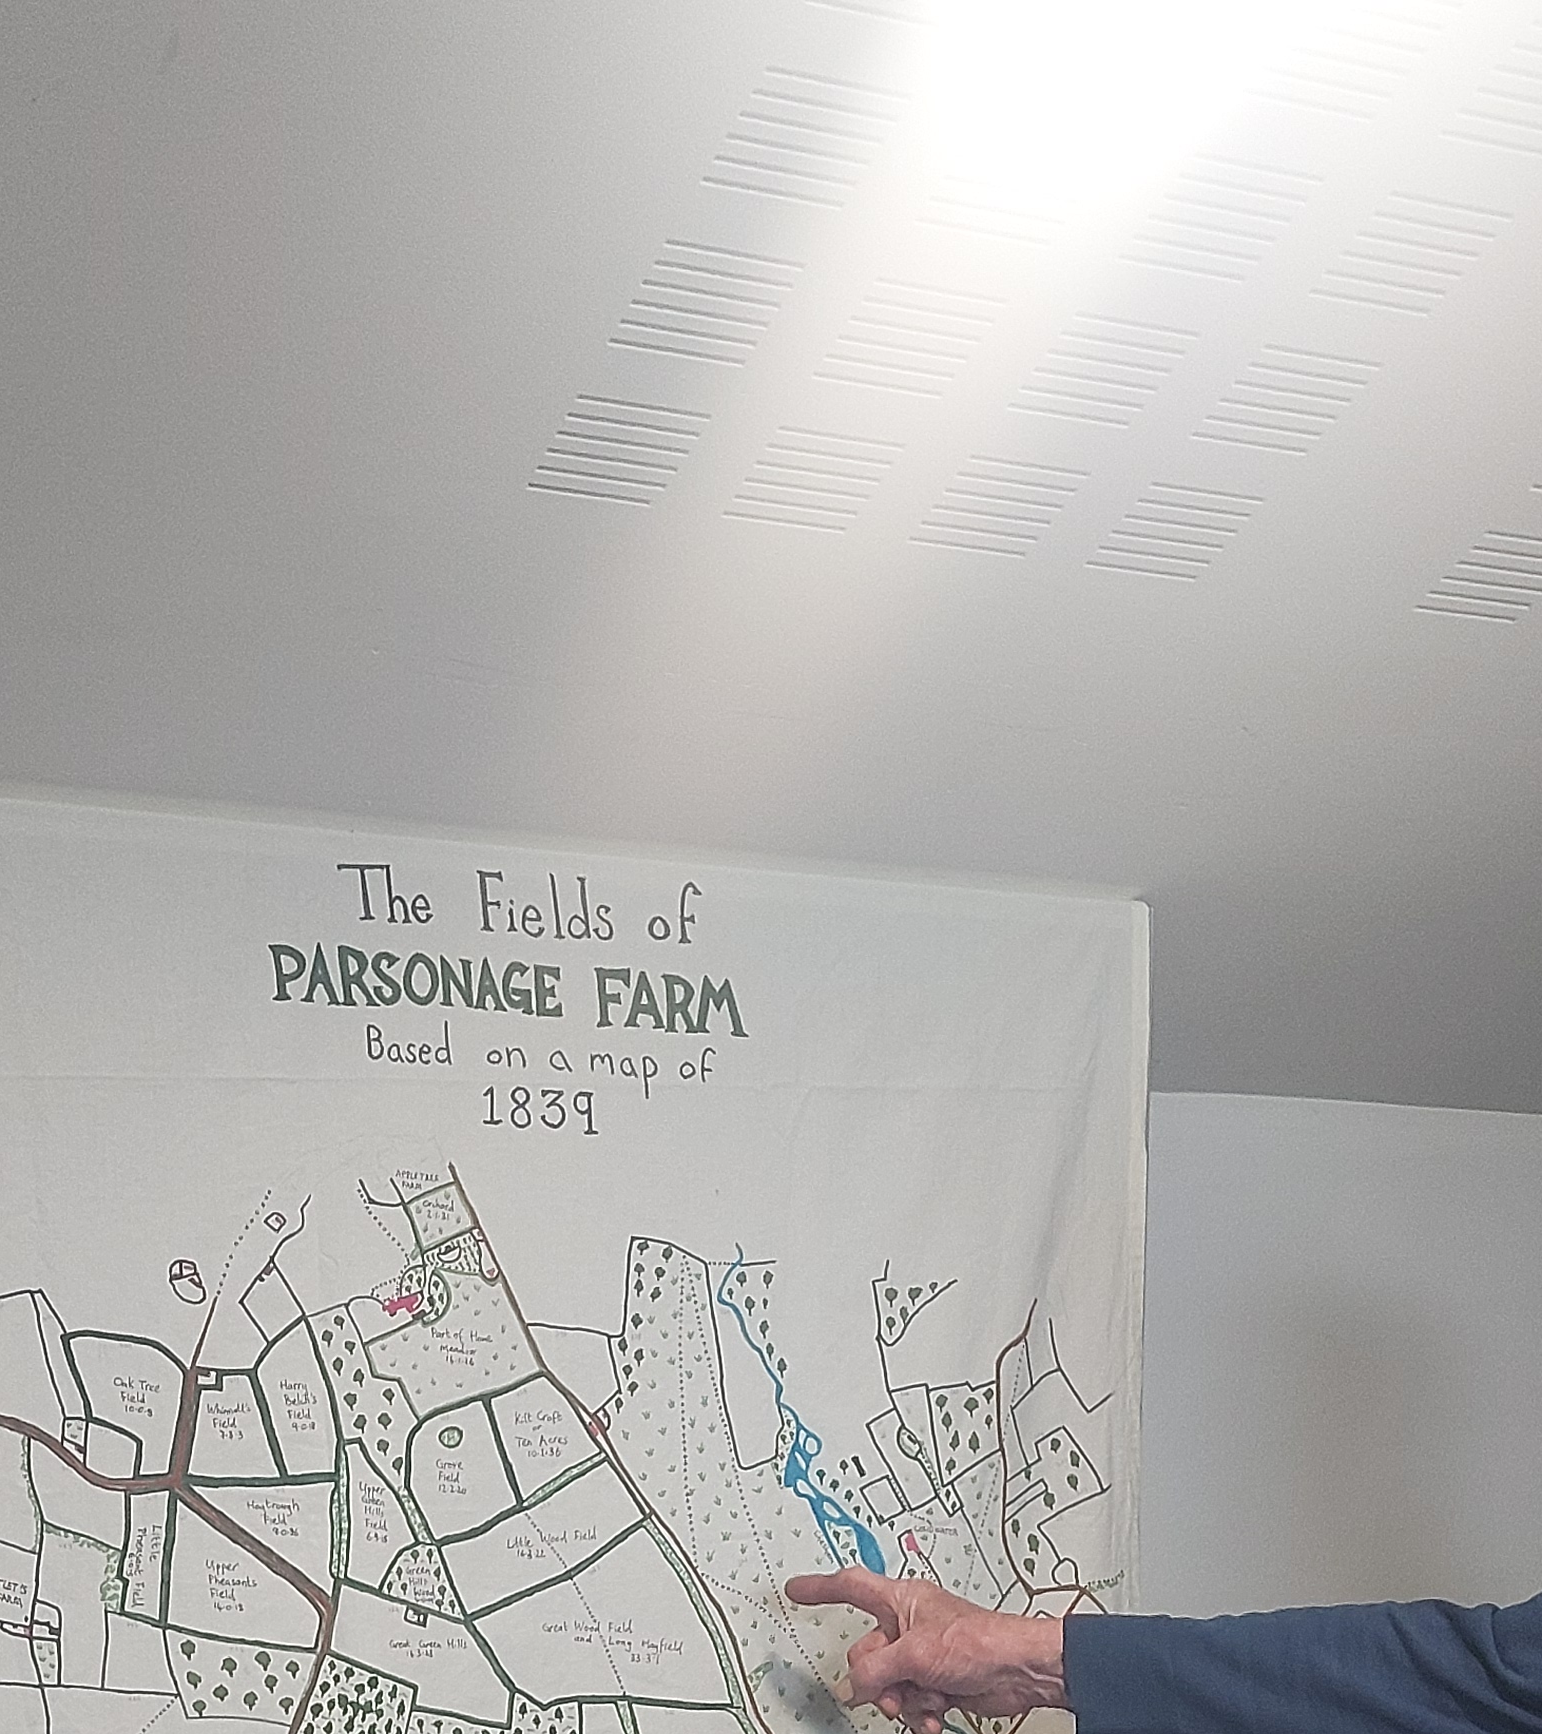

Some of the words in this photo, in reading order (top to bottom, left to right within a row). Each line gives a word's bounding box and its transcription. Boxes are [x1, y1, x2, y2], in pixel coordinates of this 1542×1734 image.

[336, 863, 434, 925] The
[475, 869, 614, 942] Fields
[647, 881, 703, 945] of
[267, 941, 564, 1018] PARSONAGE
[593, 966, 750, 1038] FARM
[366, 1020, 453, 1066] Based
[486, 1046, 527, 1069] on
[548, 1049, 573, 1073] a
[589, 1052, 659, 1100] map
[678, 1047, 717, 1084] of
[482, 1085, 599, 1136] 1839
